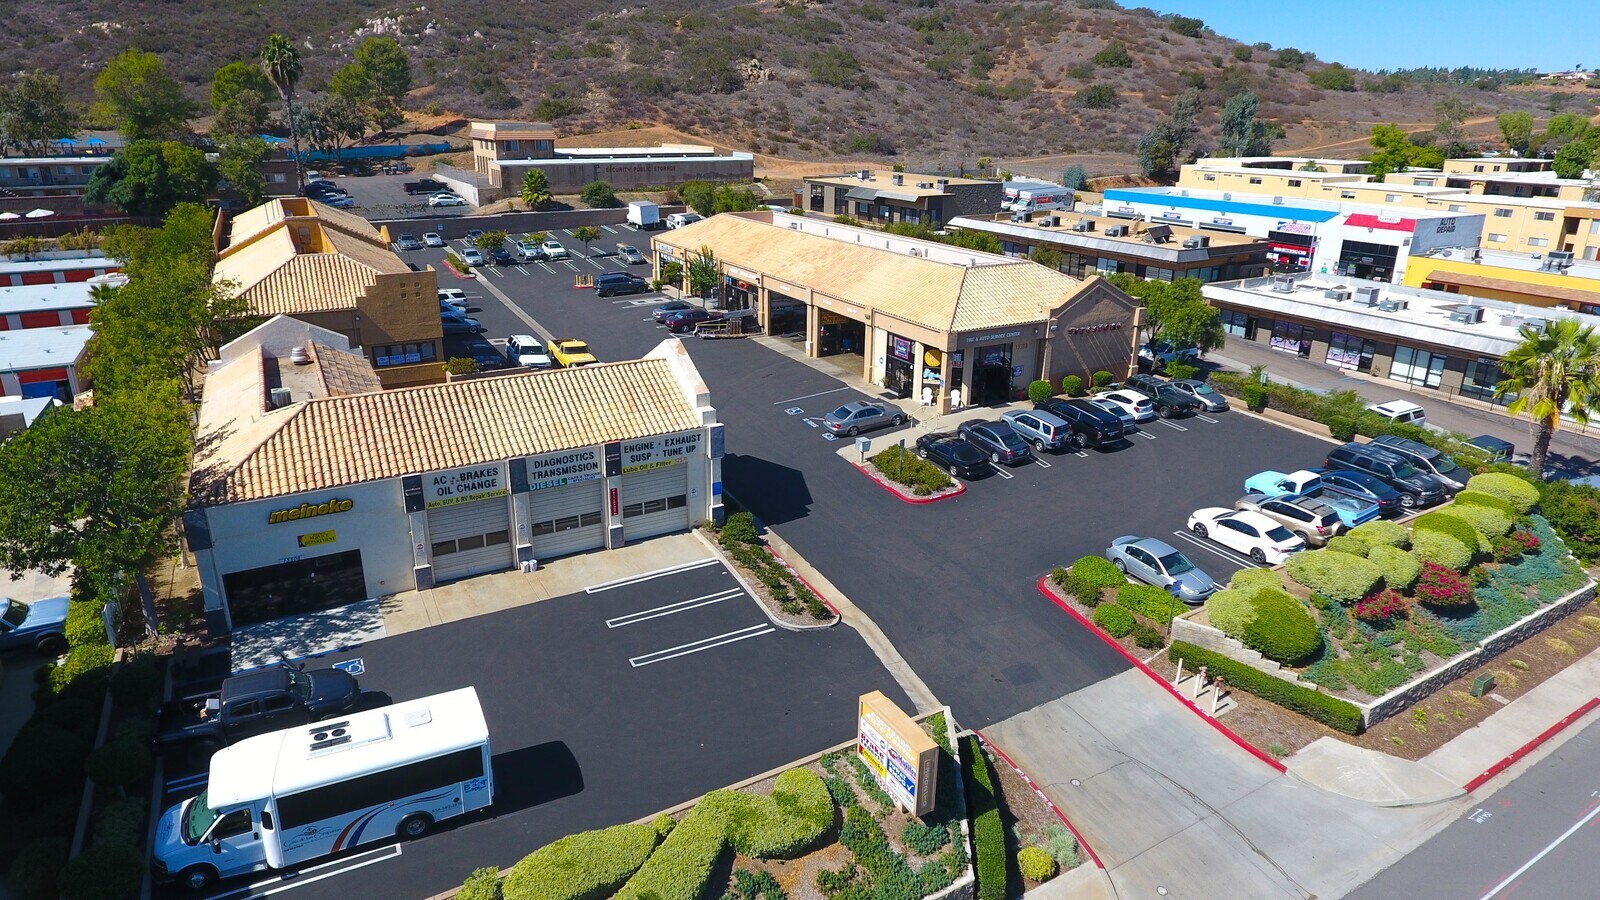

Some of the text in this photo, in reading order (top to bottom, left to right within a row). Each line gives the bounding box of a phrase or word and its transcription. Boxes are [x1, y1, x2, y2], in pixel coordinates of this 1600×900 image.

[1436, 226, 1456, 234] REPAIR
[1440, 217, 1456, 226] AUTO
[624, 434, 702, 454] ENGINE EXHAUST
[534, 451, 594, 469] DIAGNOSTICS
[630, 445, 697, 463] SUSP TUNE UP
[433, 467, 499, 486] AC BRAKES
[532, 462, 598, 480] TRANSMISSION
[623, 466, 638, 474] Lube
[437, 479, 497, 497] OIL CHANGE
[530, 479, 565, 491] DIESEL
[469, 492, 486, 502] Repair
[487, 490, 506, 498] Service
[268, 499, 354, 525] meineke
[860, 732, 884, 758] Brake
